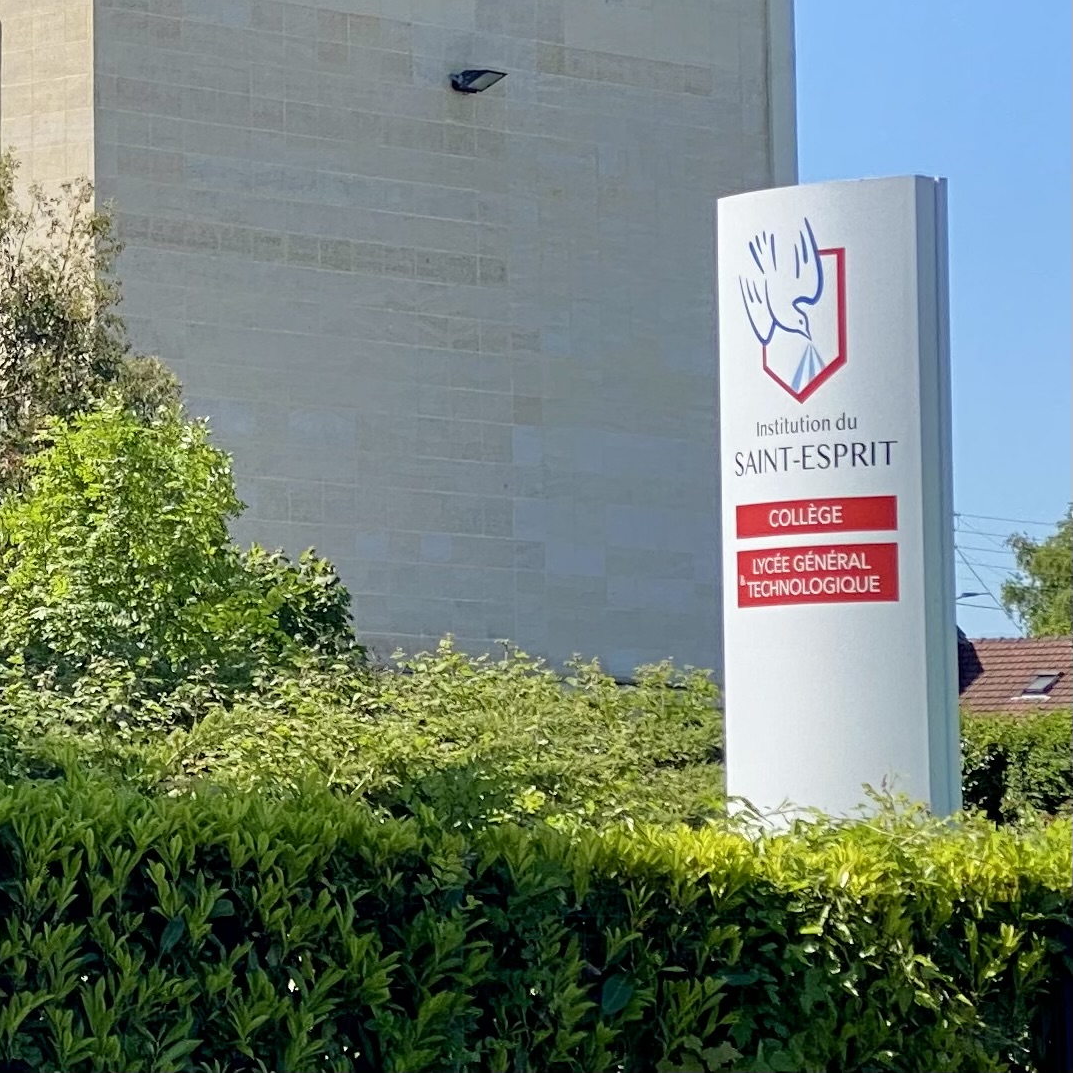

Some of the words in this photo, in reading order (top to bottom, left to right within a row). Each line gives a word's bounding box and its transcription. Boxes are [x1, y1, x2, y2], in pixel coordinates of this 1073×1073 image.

[756, 414, 831, 437] Institution
[835, 412, 858, 431] du
[734, 440, 898, 477] SAINT-ESPRIT
[769, 503, 843, 528] COLLÈGE
[752, 552, 791, 575] LYCÉE
[793, 549, 872, 572] GÉNÉRAL
[739, 575, 746, 587] &
[746, 575, 881, 599] TECHNOLOGIQUE
